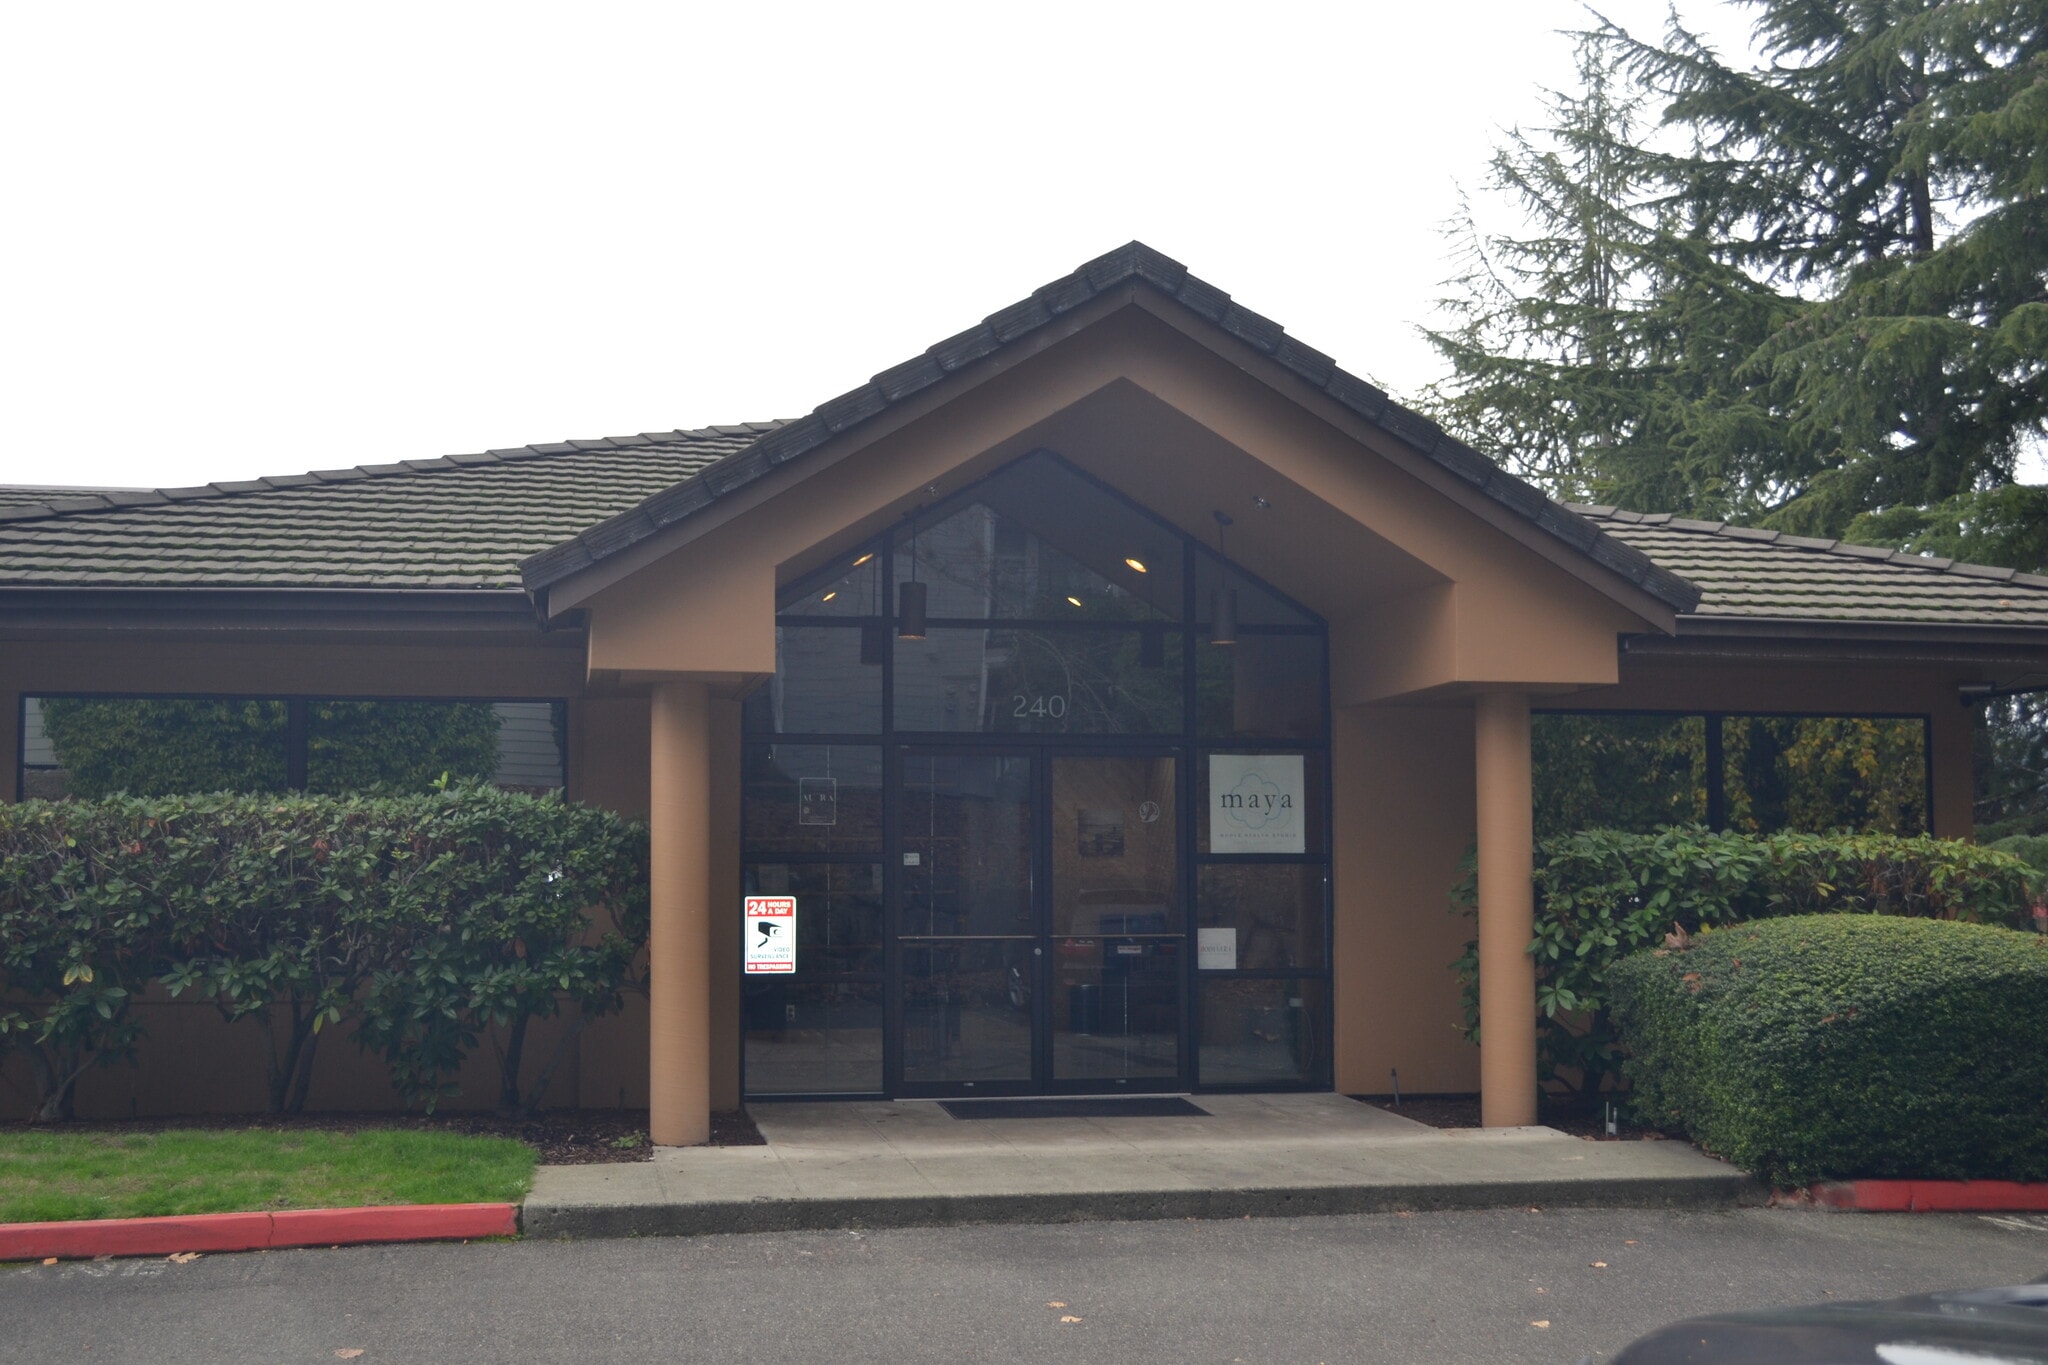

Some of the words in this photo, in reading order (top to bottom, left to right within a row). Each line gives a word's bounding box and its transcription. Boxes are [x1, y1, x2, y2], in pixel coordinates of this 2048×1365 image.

[1013, 695, 1065, 718] 240
[1220, 793, 1293, 816] maya
[748, 901, 767, 915] 24
[767, 901, 791, 909] HOURS
